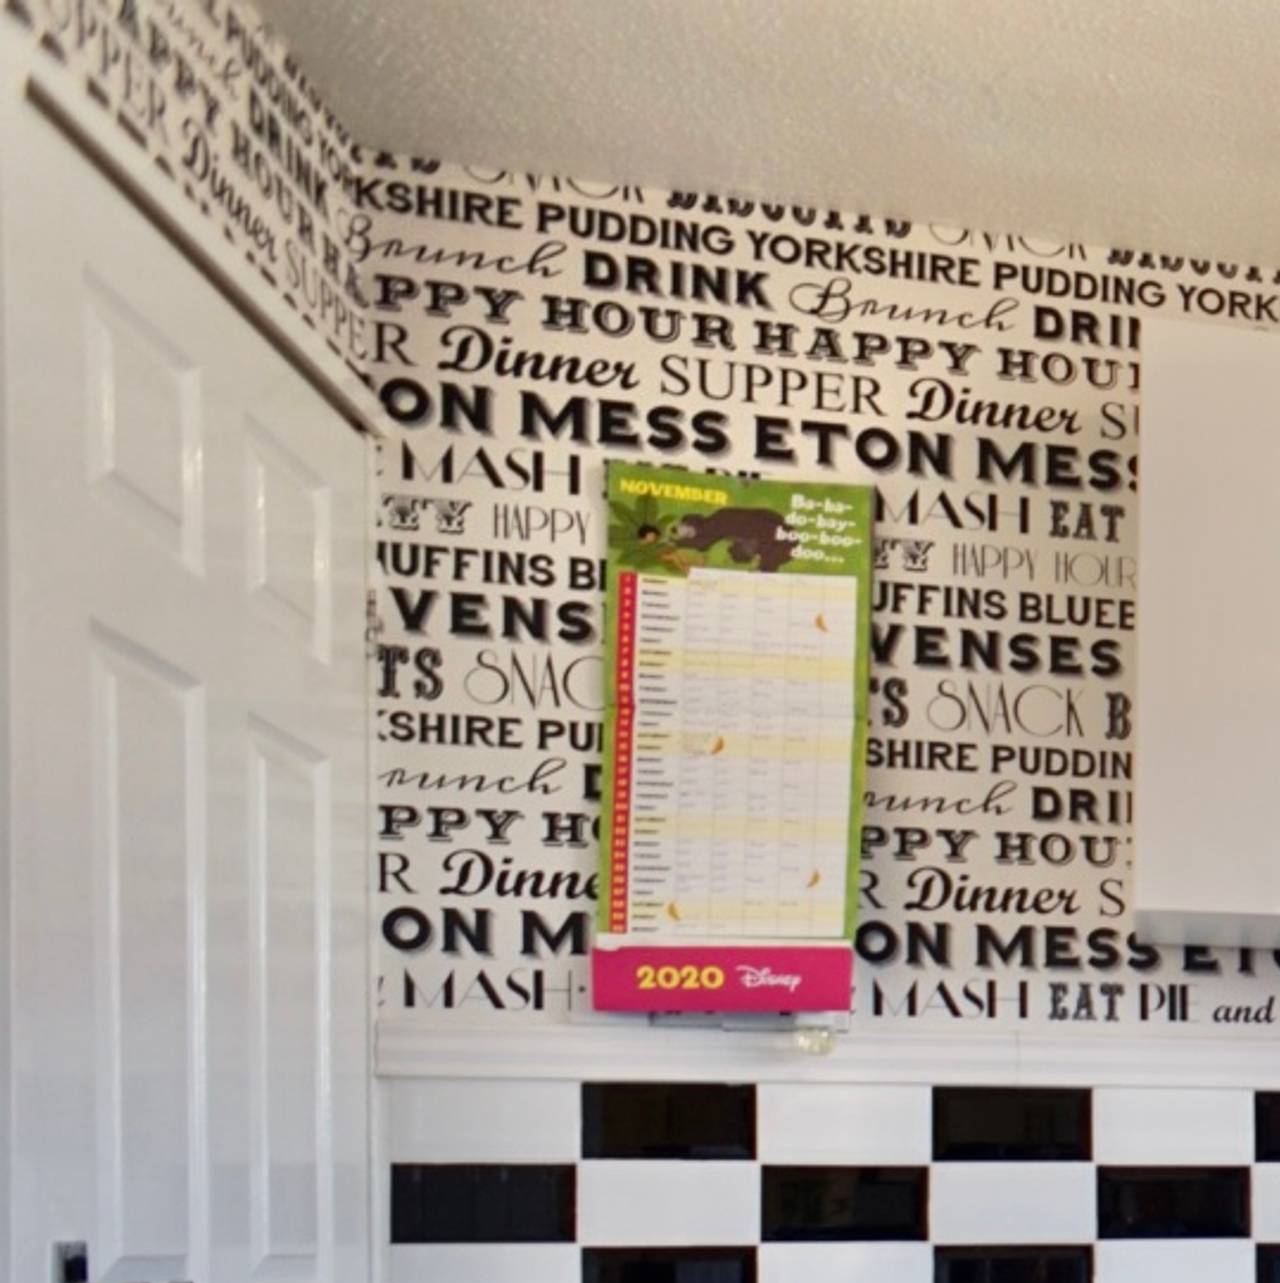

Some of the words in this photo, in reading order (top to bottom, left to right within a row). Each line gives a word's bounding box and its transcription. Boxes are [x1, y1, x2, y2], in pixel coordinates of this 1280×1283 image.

[337, 207, 568, 279] Brunch
[582, 249, 776, 311] DRINK
[789, 276, 1020, 333] Brunch
[1032, 304, 1140, 350] DRI
[536, 201, 734, 255] PUDDING
[747, 229, 980, 288] YORKSHIRE
[993, 261, 1166, 309] PUDDING
[542, 294, 737, 352] HOUR
[753, 319, 981, 377] HAPPY
[437, 324, 639, 391] Dinner
[660, 354, 887, 418] SUPPER
[906, 377, 1083, 435] Dinner
[380, 376, 496, 436] ON
[519, 390, 738, 457] MESS
[753, 413, 957, 482] ETON
[402, 438, 581, 495] MASH
[874, 484, 1029, 535] MASH
[1049, 499, 1125, 543] EAT
[619, 478, 728, 506] NOVEMBER
[493, 502, 592, 546] HAPPY
[952, 541, 1042, 581] HAPPY
[872, 623, 1123, 679] VENSES
[464, 648, 605, 712] SNAC
[926, 679, 1086, 738] SNACK
[377, 710, 523, 749] SHIRE
[866, 736, 978, 773] SHIRE
[991, 745, 1133, 781] PUDDIN
[377, 757, 568, 795] runch
[864, 779, 1018, 816] runch
[1031, 785, 1133, 826] DRI
[377, 804, 526, 846] PPY
[861, 825, 980, 864] PPY
[994, 830, 1133, 870] HOU
[903, 865, 1082, 915] Dinner
[381, 905, 494, 959] ON
[855, 919, 954, 970] ON
[974, 922, 1162, 973] MESS
[636, 964, 725, 991] 2020
[735, 964, 801, 993] Disney
[872, 978, 1028, 1020] MASH
[1048, 980, 1125, 1021] EAT
[1140, 982, 1199, 1023] PIE
[1212, 995, 1276, 1024] and
